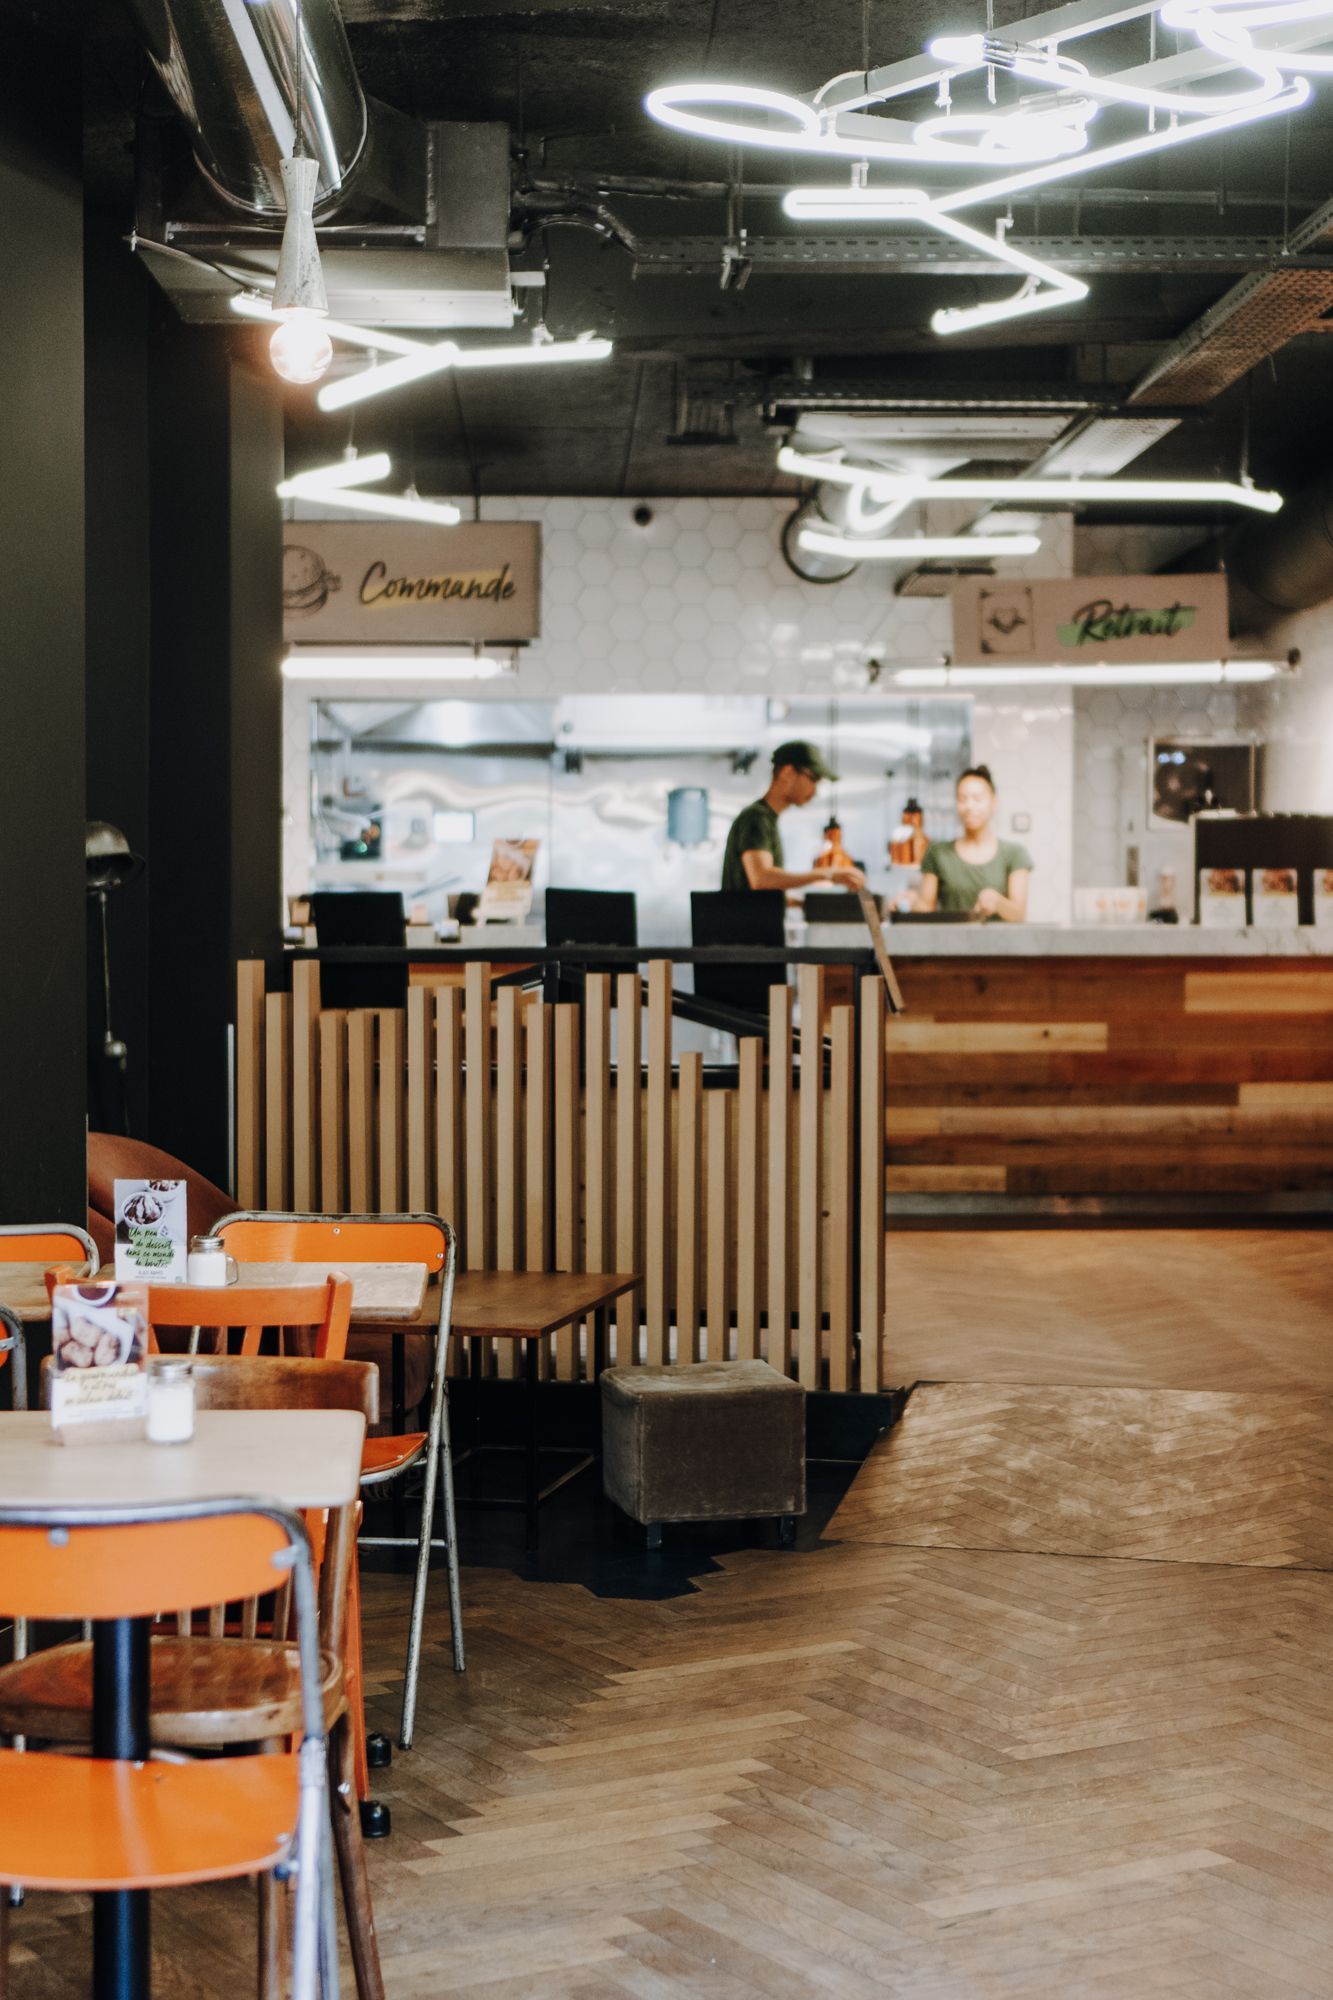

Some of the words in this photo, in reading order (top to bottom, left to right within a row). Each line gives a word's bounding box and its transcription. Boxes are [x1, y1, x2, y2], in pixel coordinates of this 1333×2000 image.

[360, 561, 516, 604] Commande
[1071, 599, 1196, 646] Retrait
[128, 1227, 141, 1238] Un
[144, 1230, 157, 1238] peu
[145, 1239, 172, 1249] dessert
